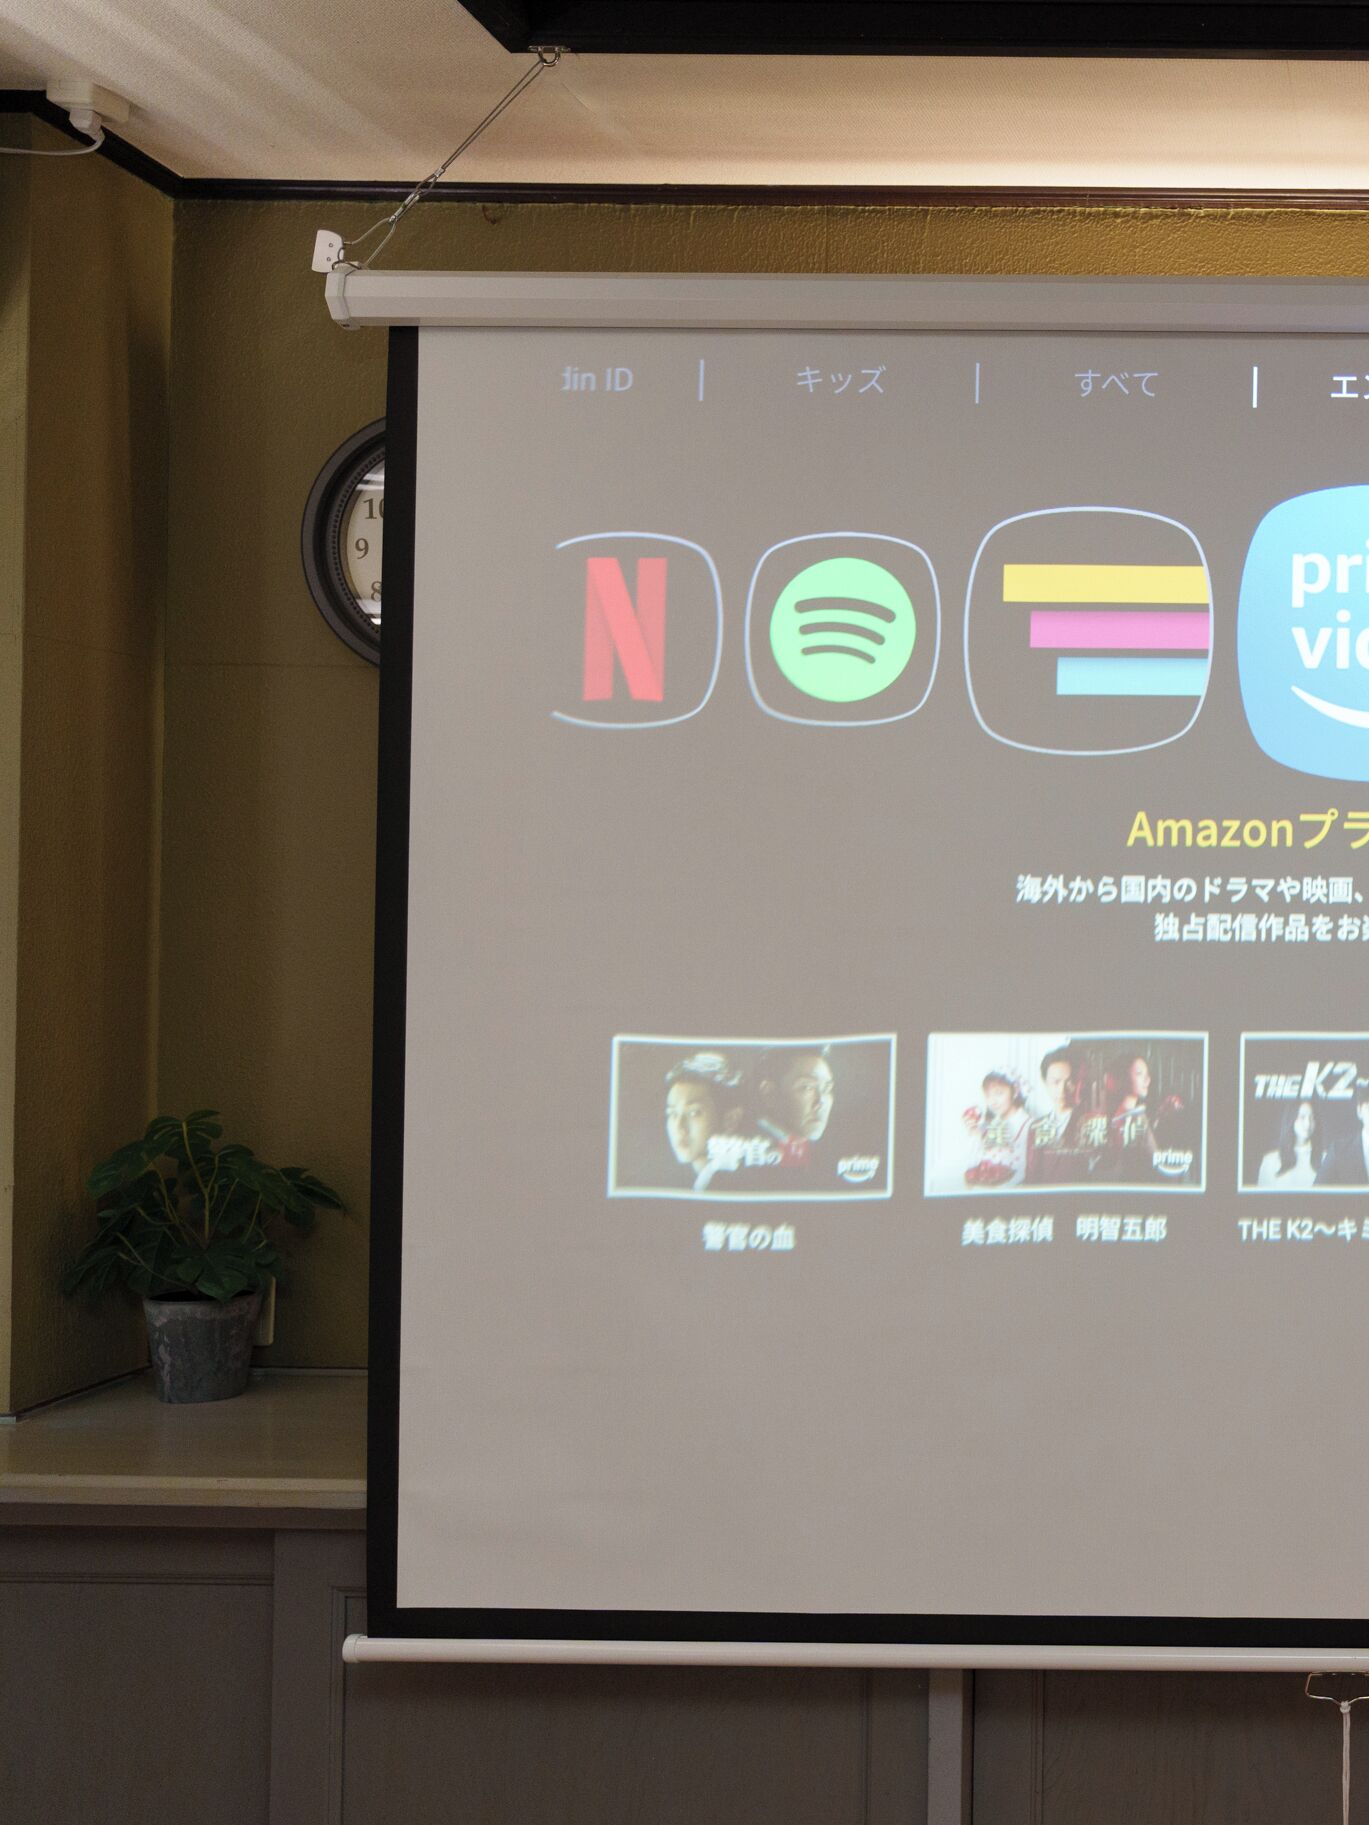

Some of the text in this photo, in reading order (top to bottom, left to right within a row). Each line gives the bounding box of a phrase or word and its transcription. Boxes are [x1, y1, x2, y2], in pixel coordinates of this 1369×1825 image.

[605, 367, 634, 392] ID
[795, 364, 886, 396] キッズ
[1073, 368, 1160, 398] すべて
[355, 538, 369, 559] 9
[961, 1214, 1168, 1246] 美食探偵 明智五郎
[1237, 1218, 1282, 1242] THE
